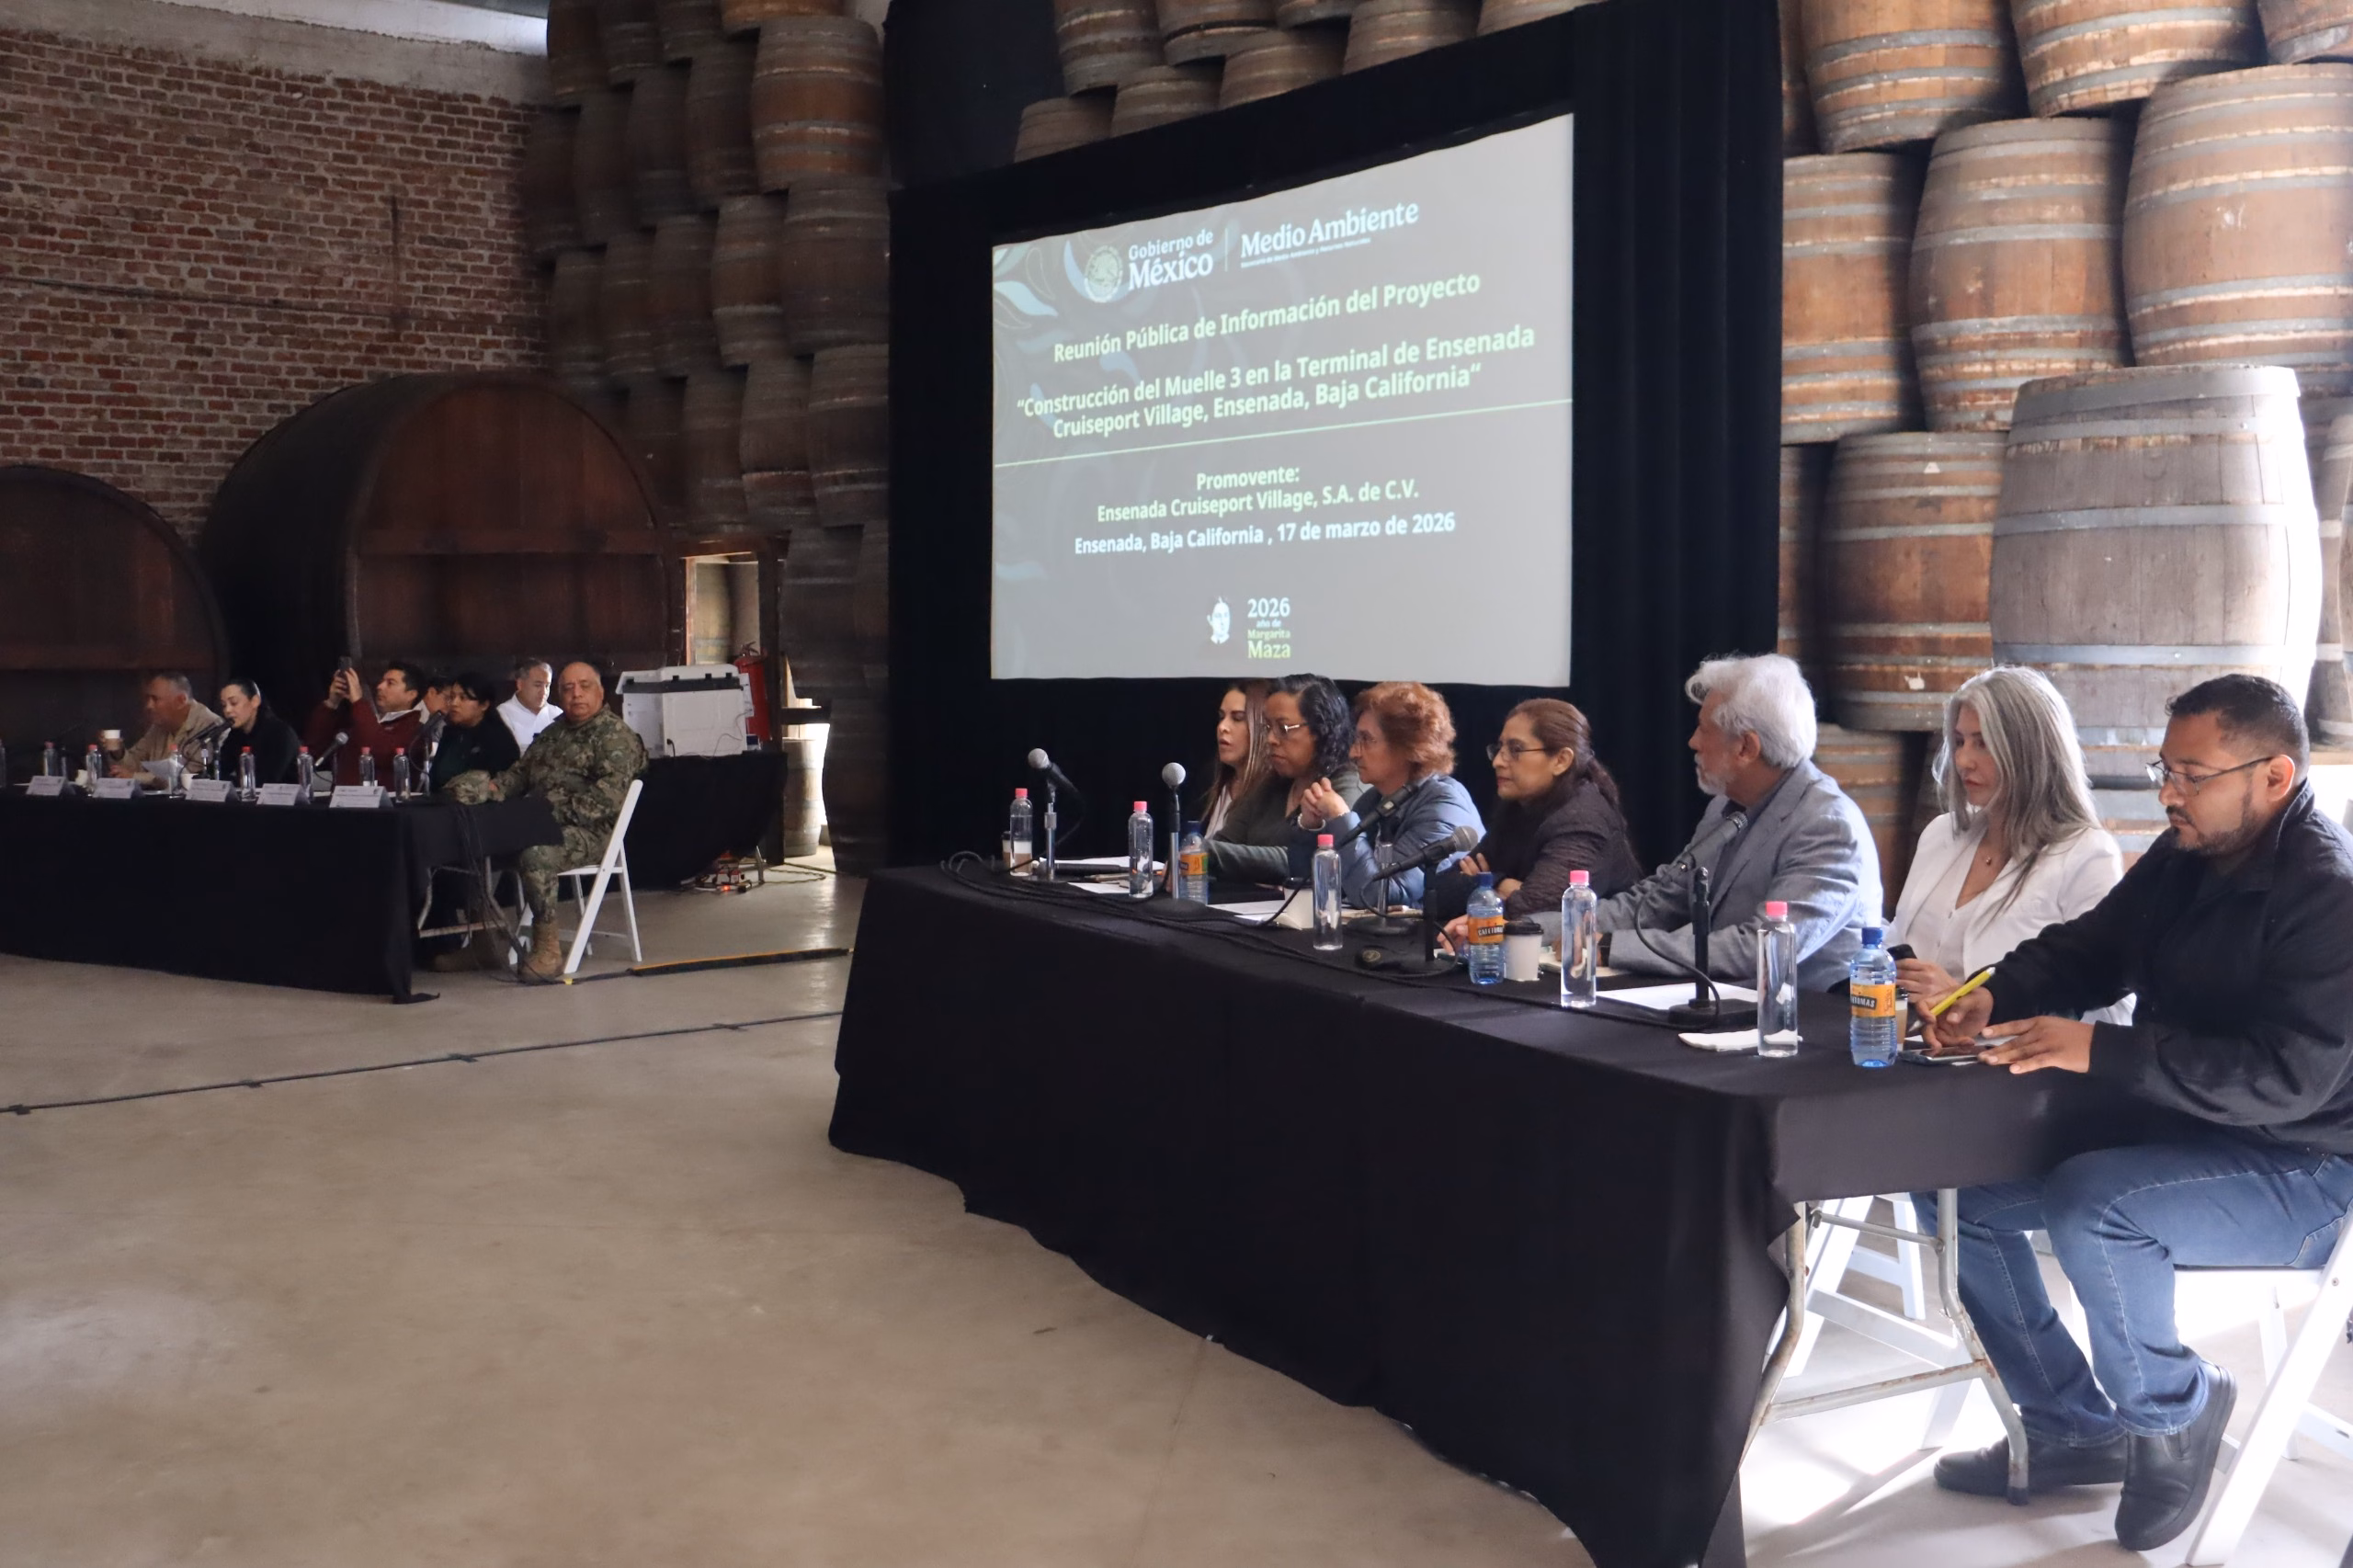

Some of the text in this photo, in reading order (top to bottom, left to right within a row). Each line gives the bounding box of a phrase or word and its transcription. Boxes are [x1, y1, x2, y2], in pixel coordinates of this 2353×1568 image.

[1129, 228, 1213, 261] Gobierno de
[1241, 224, 1305, 257] Medio
[1308, 201, 1418, 244] Ambiente
[1129, 252, 1212, 290] México
[1054, 274, 1480, 362] Reunión Pública de Información del Proyecto
[1134, 379, 1160, 402] del
[1165, 370, 1225, 397] Muelle
[1230, 367, 1241, 387] 3
[1245, 366, 1268, 384] en
[1275, 359, 1291, 382] la
[1297, 344, 1388, 378] Terminal
[1393, 341, 1419, 365] de
[1427, 324, 1534, 360] Ensenada
[1053, 411, 1140, 438] Cruiseport
[1143, 403, 1209, 428] Village,
[1214, 388, 1310, 418] Ensenada,
[1315, 381, 1358, 409] Baja
[1197, 467, 1300, 491] Promovente:
[1097, 479, 1419, 522] Ensenada Cruiseport Village, S.A. de C.V.
[1074, 532, 1146, 554] Ensenada,
[1151, 531, 1183, 552] Baja
[1187, 526, 1264, 548] California
[1277, 523, 1296, 542] 17
[1300, 521, 1322, 540] de
[1325, 520, 1380, 539] marzo
[1385, 515, 1407, 535] de
[1413, 512, 1455, 534] 2026
[1247, 597, 1290, 618] 2026
[1271, 619, 1281, 628] de
[1247, 629, 1290, 641] Margarita
[1247, 640, 1291, 658] Maza
